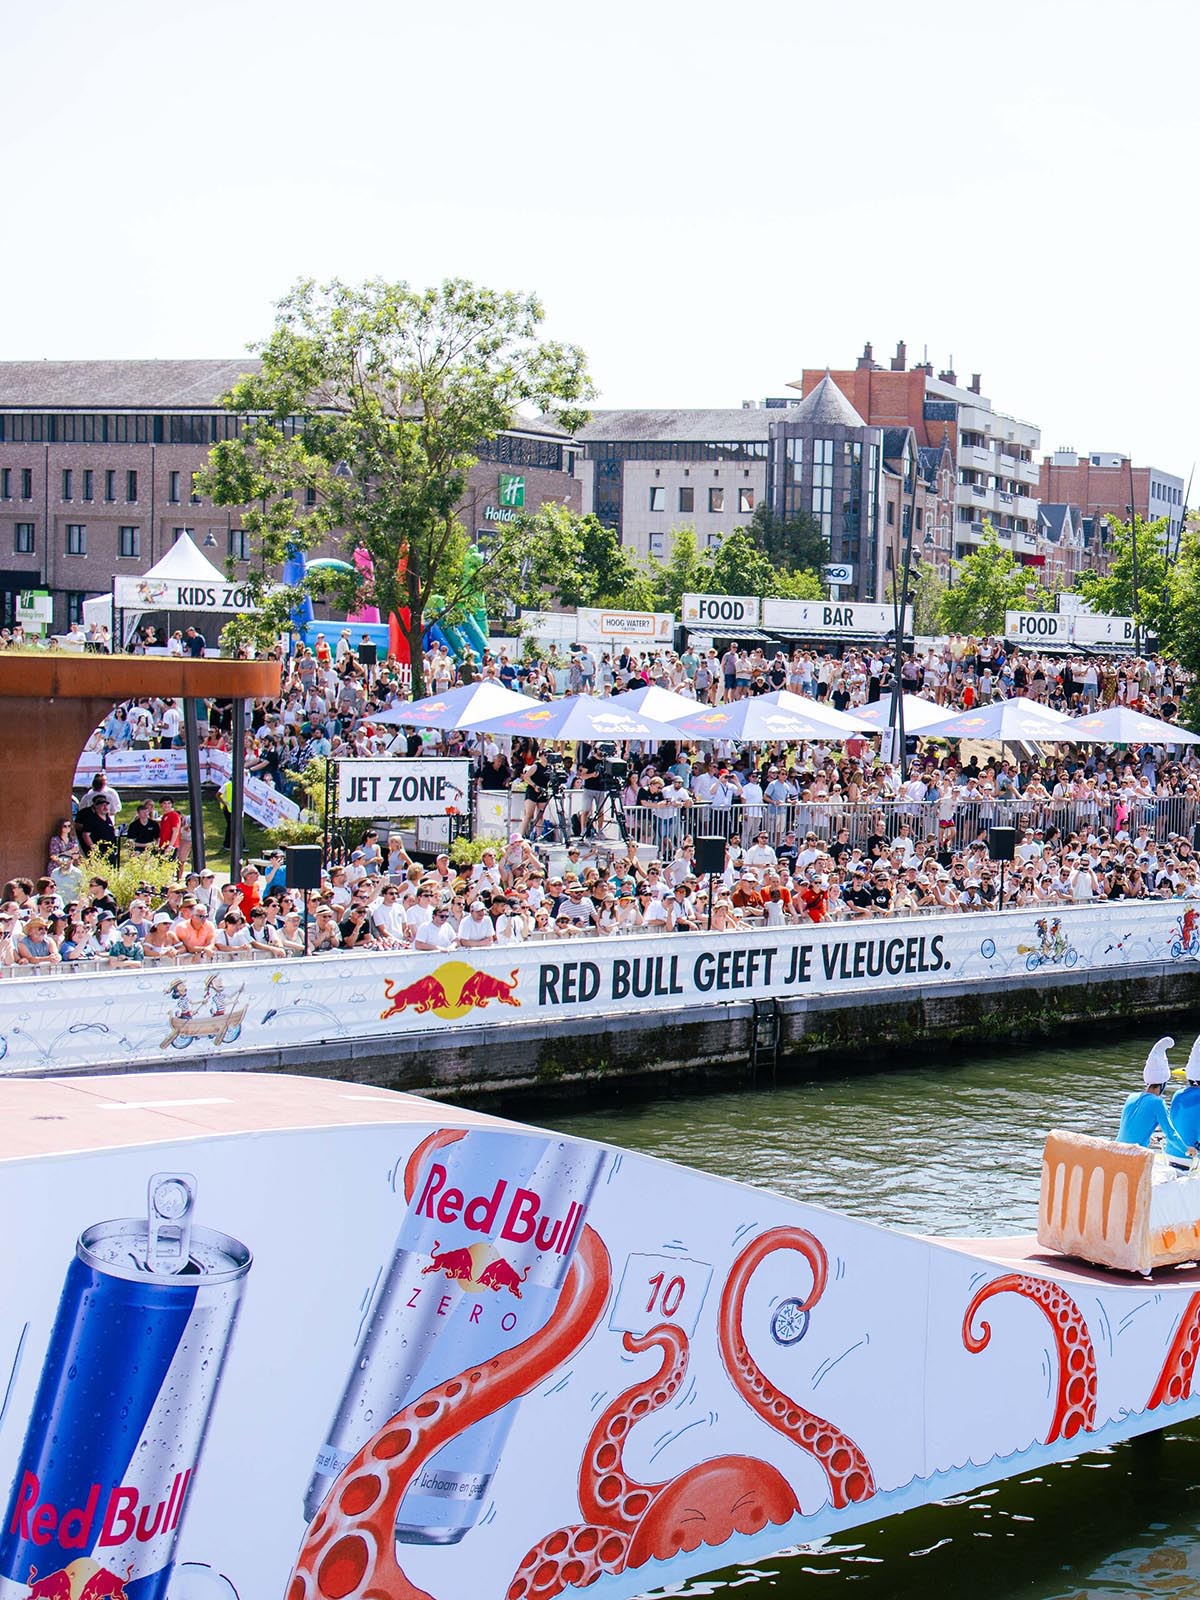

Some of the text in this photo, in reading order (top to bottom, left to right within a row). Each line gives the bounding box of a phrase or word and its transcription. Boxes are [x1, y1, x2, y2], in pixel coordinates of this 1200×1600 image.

[177, 587, 259, 607] KIDS ZON
[699, 600, 745, 620] FOOD
[823, 607, 853, 626] BAR
[606, 619, 650, 628] HOOG WATER?
[1019, 616, 1058, 635] FOOD
[346, 776, 446, 802] JET ZONE
[540, 935, 951, 1005] RED BULL GEEFT JE VLEUGELS.
[415, 1163, 583, 1255] Red Bull
[645, 1271, 686, 1317] 10
[406, 1288, 517, 1331] ZERO
[420, 1472, 458, 1491] lichaam
[459, 1483, 470, 1492] en
[10, 1468, 191, 1549] Red Bull
